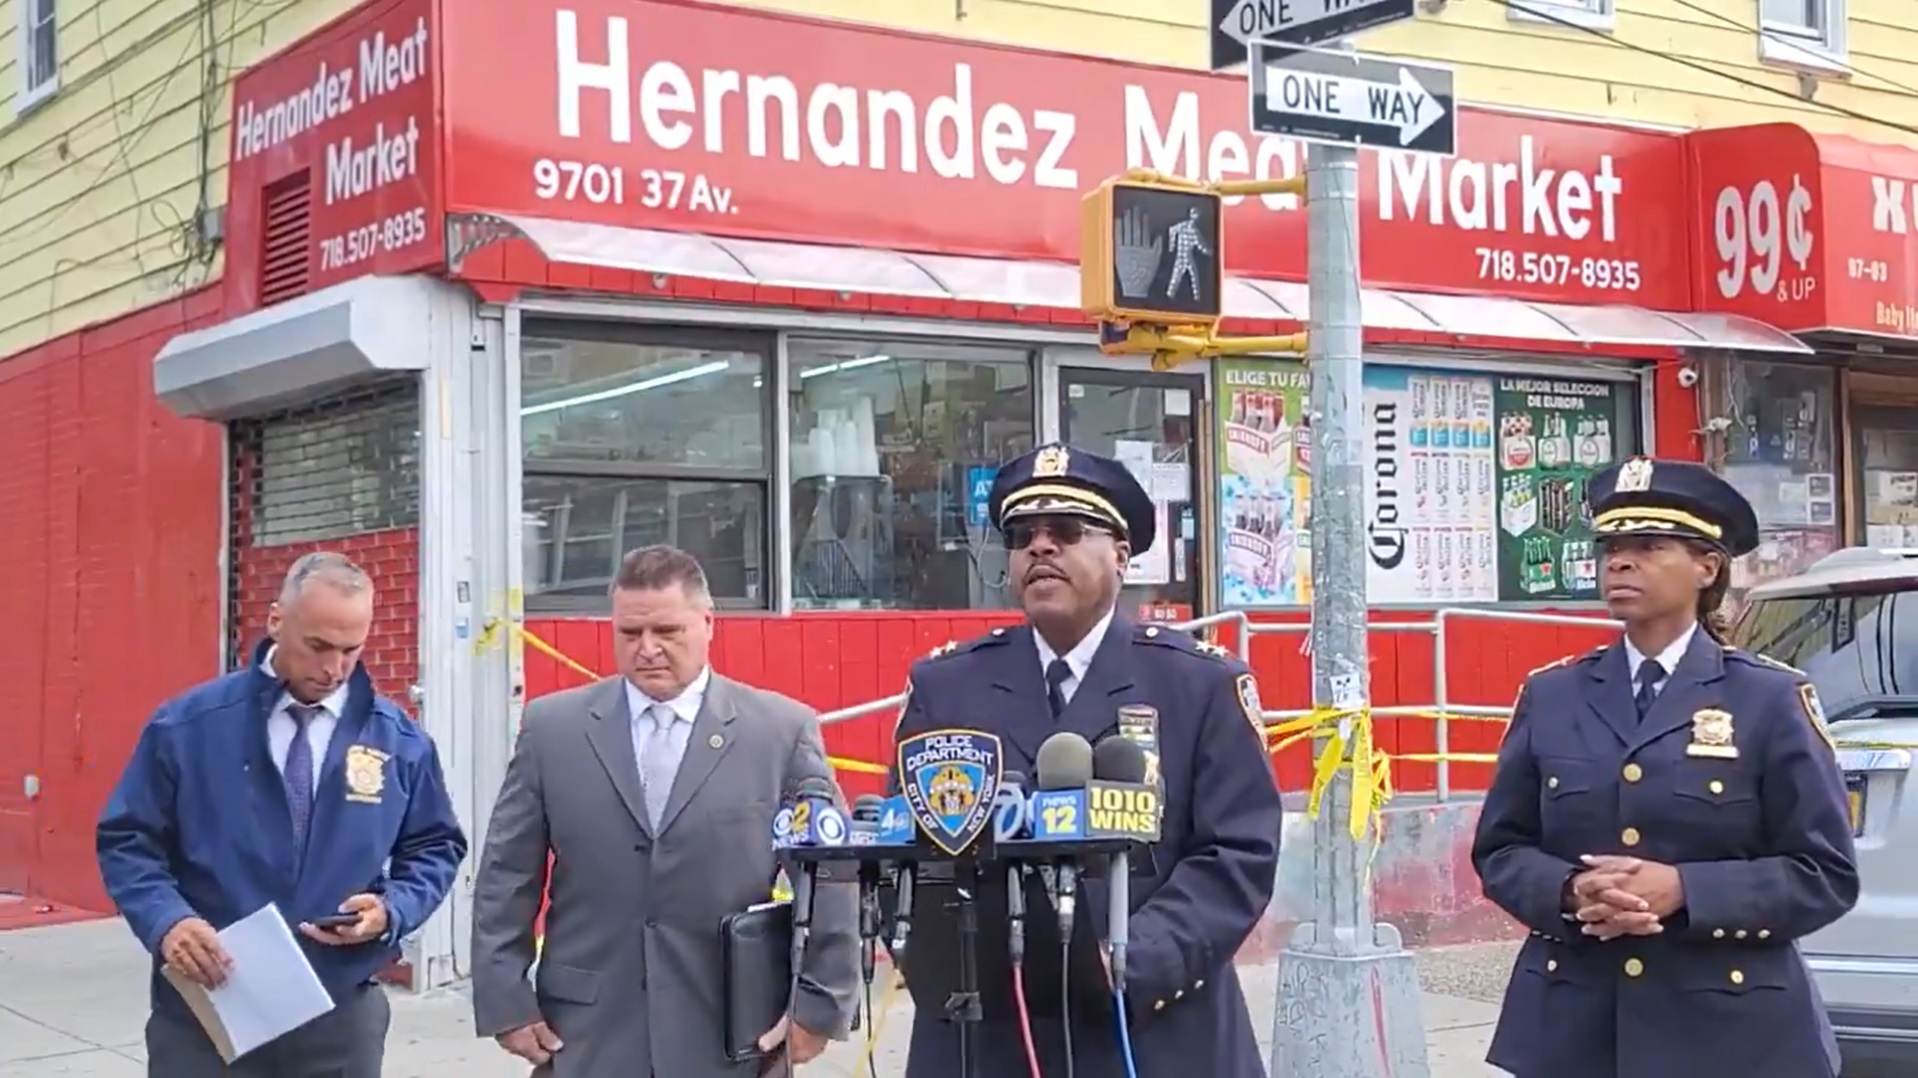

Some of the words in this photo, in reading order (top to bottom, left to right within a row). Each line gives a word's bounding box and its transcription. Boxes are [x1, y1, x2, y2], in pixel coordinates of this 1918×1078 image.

[1240, 0, 1293, 35] ONE
[236, 62, 353, 160] Hernandez
[359, 17, 428, 103] Meat
[1283, 74, 1341, 114] ONE
[1367, 86, 1425, 125] WAY
[556, 9, 1078, 190] Hernandez
[1123, 85, 1308, 211] Mea
[326, 117, 419, 205] Market
[534, 158, 623, 203] 9701
[641, 169, 685, 210] 37
[688, 174, 739, 215] Av.
[1378, 135, 1622, 242] Market
[320, 213, 426, 272] 718.507-8935
[1715, 172, 1814, 299] 99¢
[1475, 247, 1641, 290] 718.507-8935
[1776, 279, 1788, 303] &
[1792, 276, 1816, 301] UP
[1876, 300, 1904, 330] Baby
[1226, 369, 1266, 387] ELIGE
[1268, 370, 1288, 388] TU
[1500, 378, 1514, 391] LA
[1516, 379, 1552, 394] MEJOR
[1553, 381, 1610, 397] SELECCION
[1527, 394, 1542, 408] DE
[1543, 395, 1585, 410] EUROPA
[1367, 402, 1409, 570] Corona
[906, 746, 994, 771] DEPARTMENT
[925, 735, 972, 750] POLICE
[791, 800, 811, 833] 2
[907, 783, 926, 812] CITY
[922, 813, 939, 830] OF
[967, 805, 986, 833] NEW
[982, 774, 996, 803] YORK
[1042, 796, 1078, 807] news
[1090, 786, 1156, 814] 1010
[1042, 805, 1077, 835] 12
[1089, 809, 1156, 834] WINS
